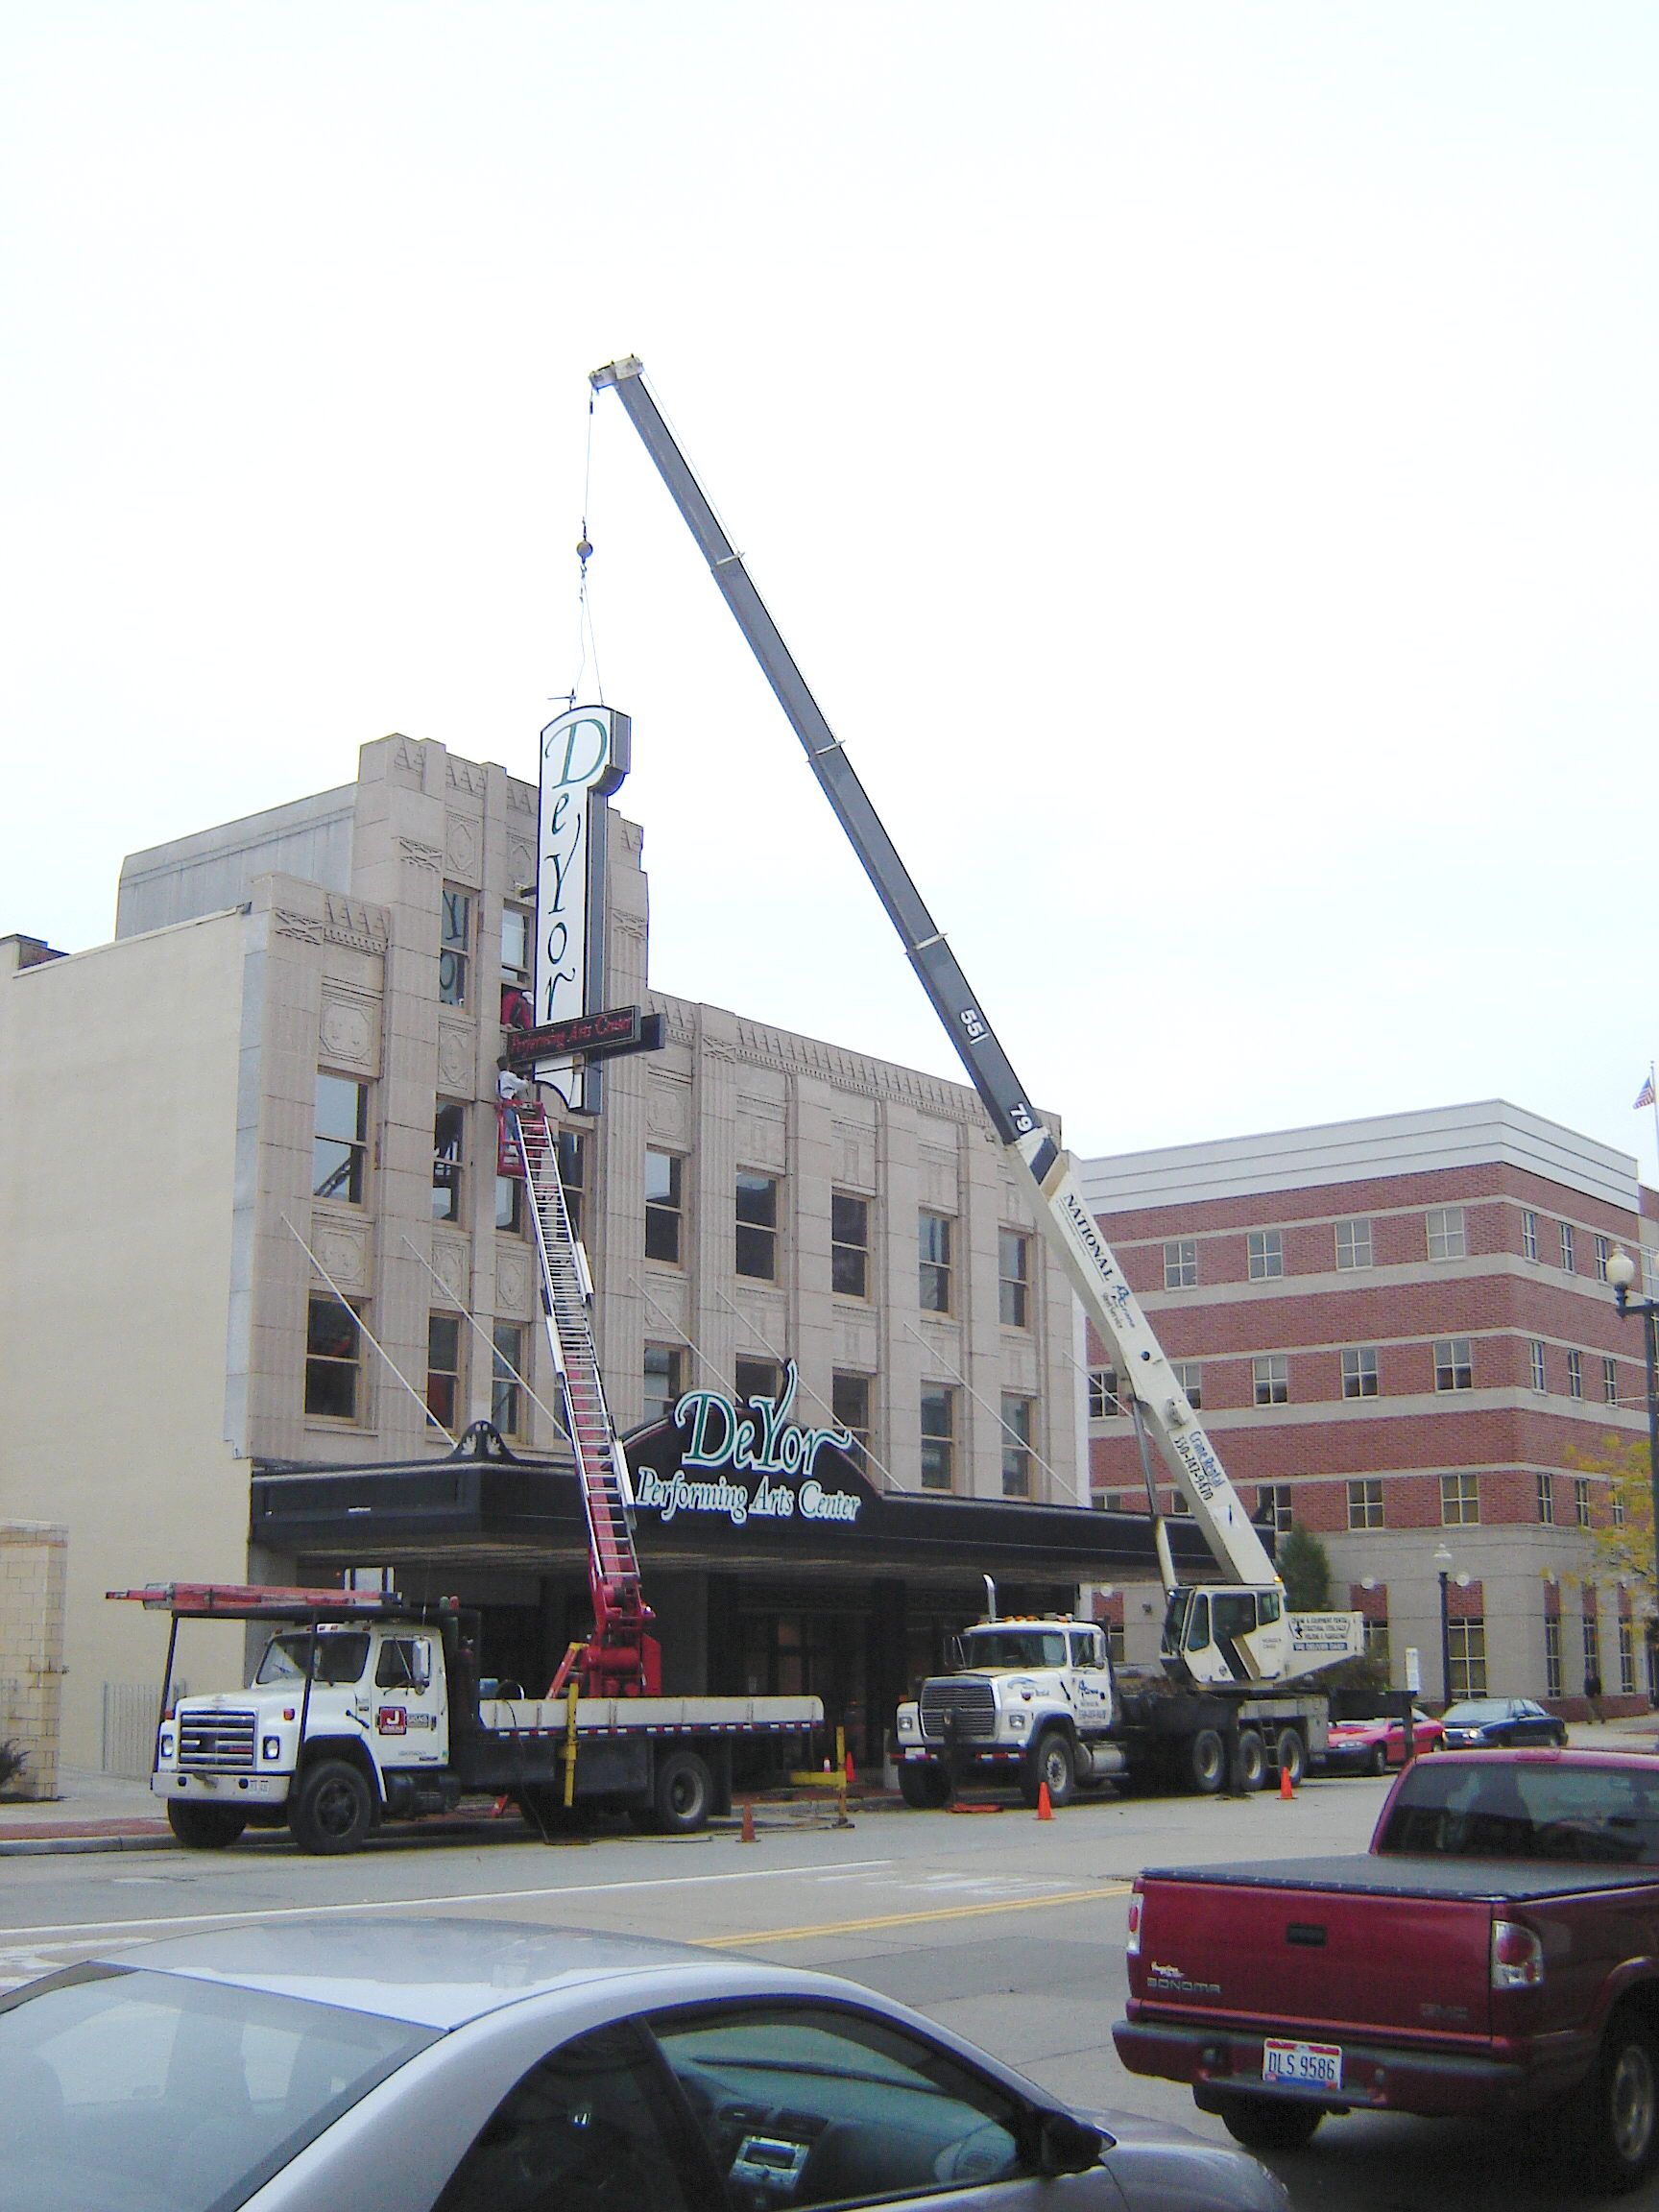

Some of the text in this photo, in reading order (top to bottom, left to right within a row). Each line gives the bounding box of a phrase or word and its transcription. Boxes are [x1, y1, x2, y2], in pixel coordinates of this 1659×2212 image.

[511, 1014, 633, 1057] Performing Arts Center
[1010, 1103, 1034, 1132] 79
[1064, 1193, 1114, 1281] NATIONAL
[674, 1358, 853, 1476] DeYor
[1189, 1431, 1225, 1488] Crane Rental
[636, 1465, 862, 1525] Performing Arts Center
[1146, 1976, 1221, 1994] SONOMA
[1268, 2051, 1335, 2080] DLS 9586
